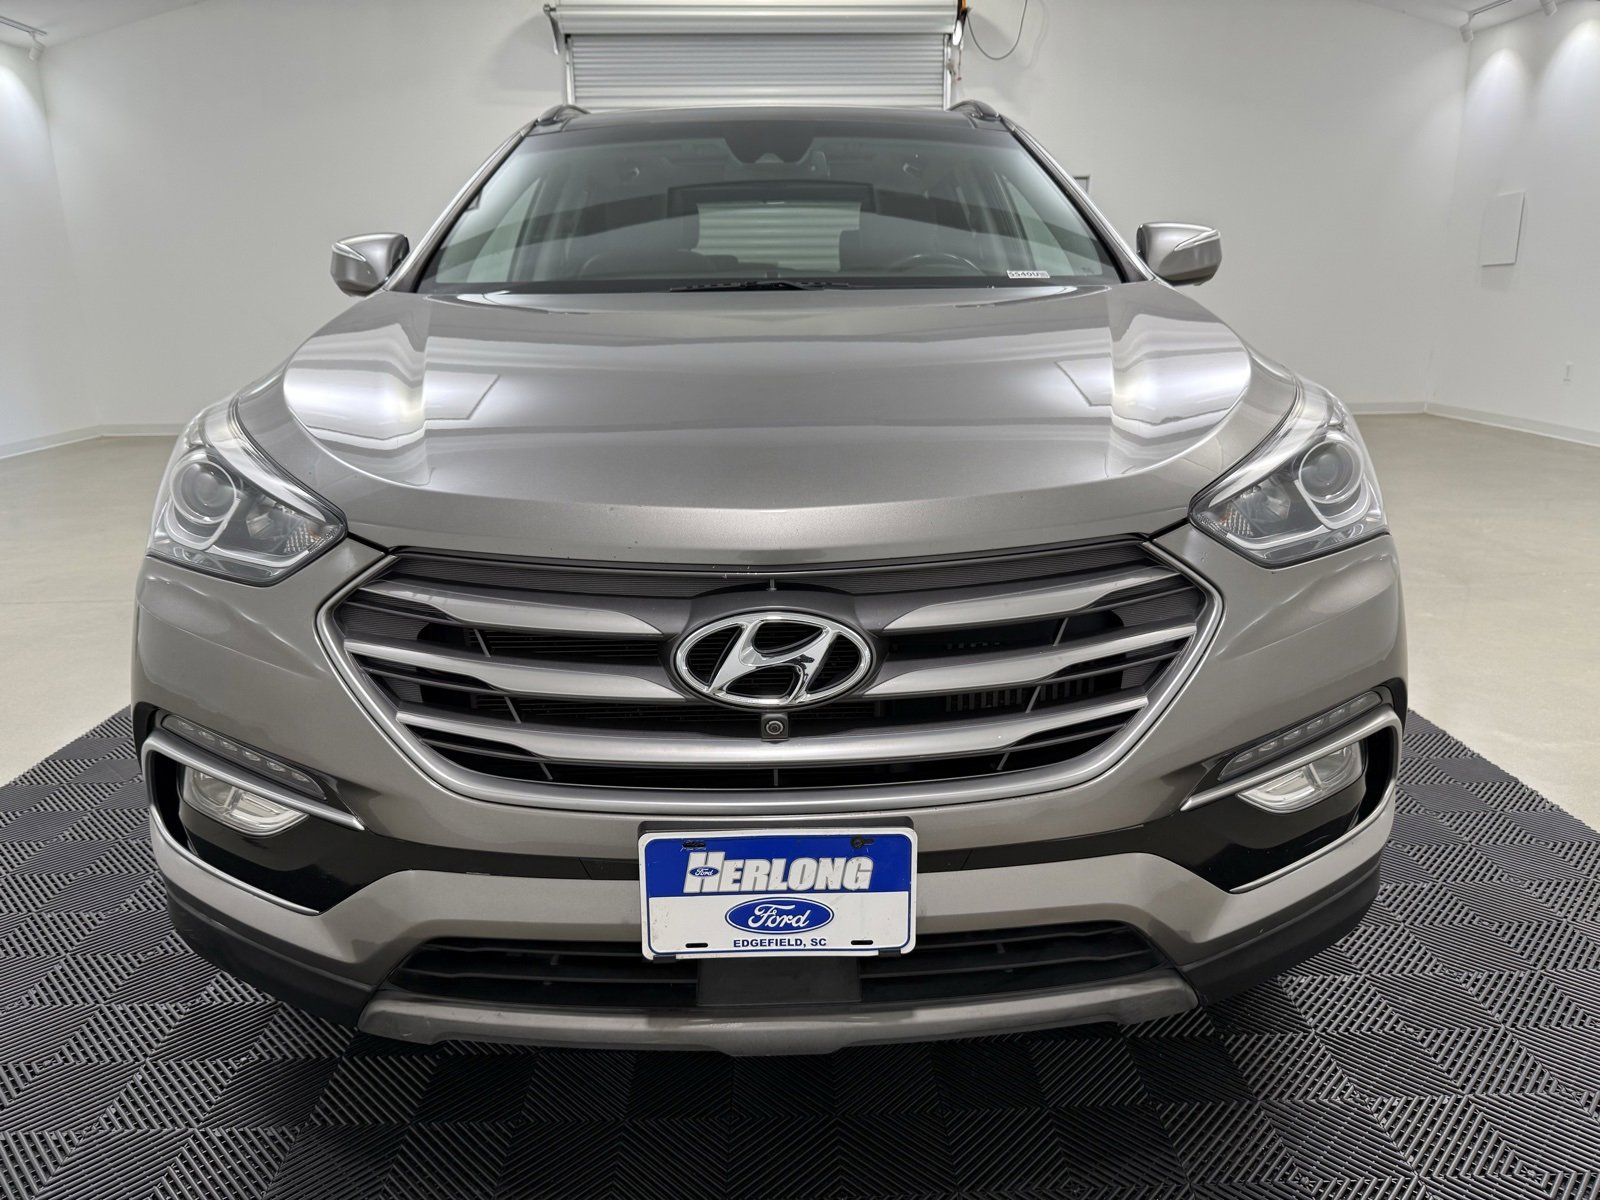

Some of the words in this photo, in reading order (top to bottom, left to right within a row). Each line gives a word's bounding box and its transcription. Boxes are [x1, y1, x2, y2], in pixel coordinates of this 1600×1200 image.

[683, 851, 874, 894] HERLONG
[694, 867, 714, 876] Ford
[747, 903, 812, 928] Ford
[733, 938, 806, 948] EDGEFIELD,
[810, 938, 827, 947] SC
